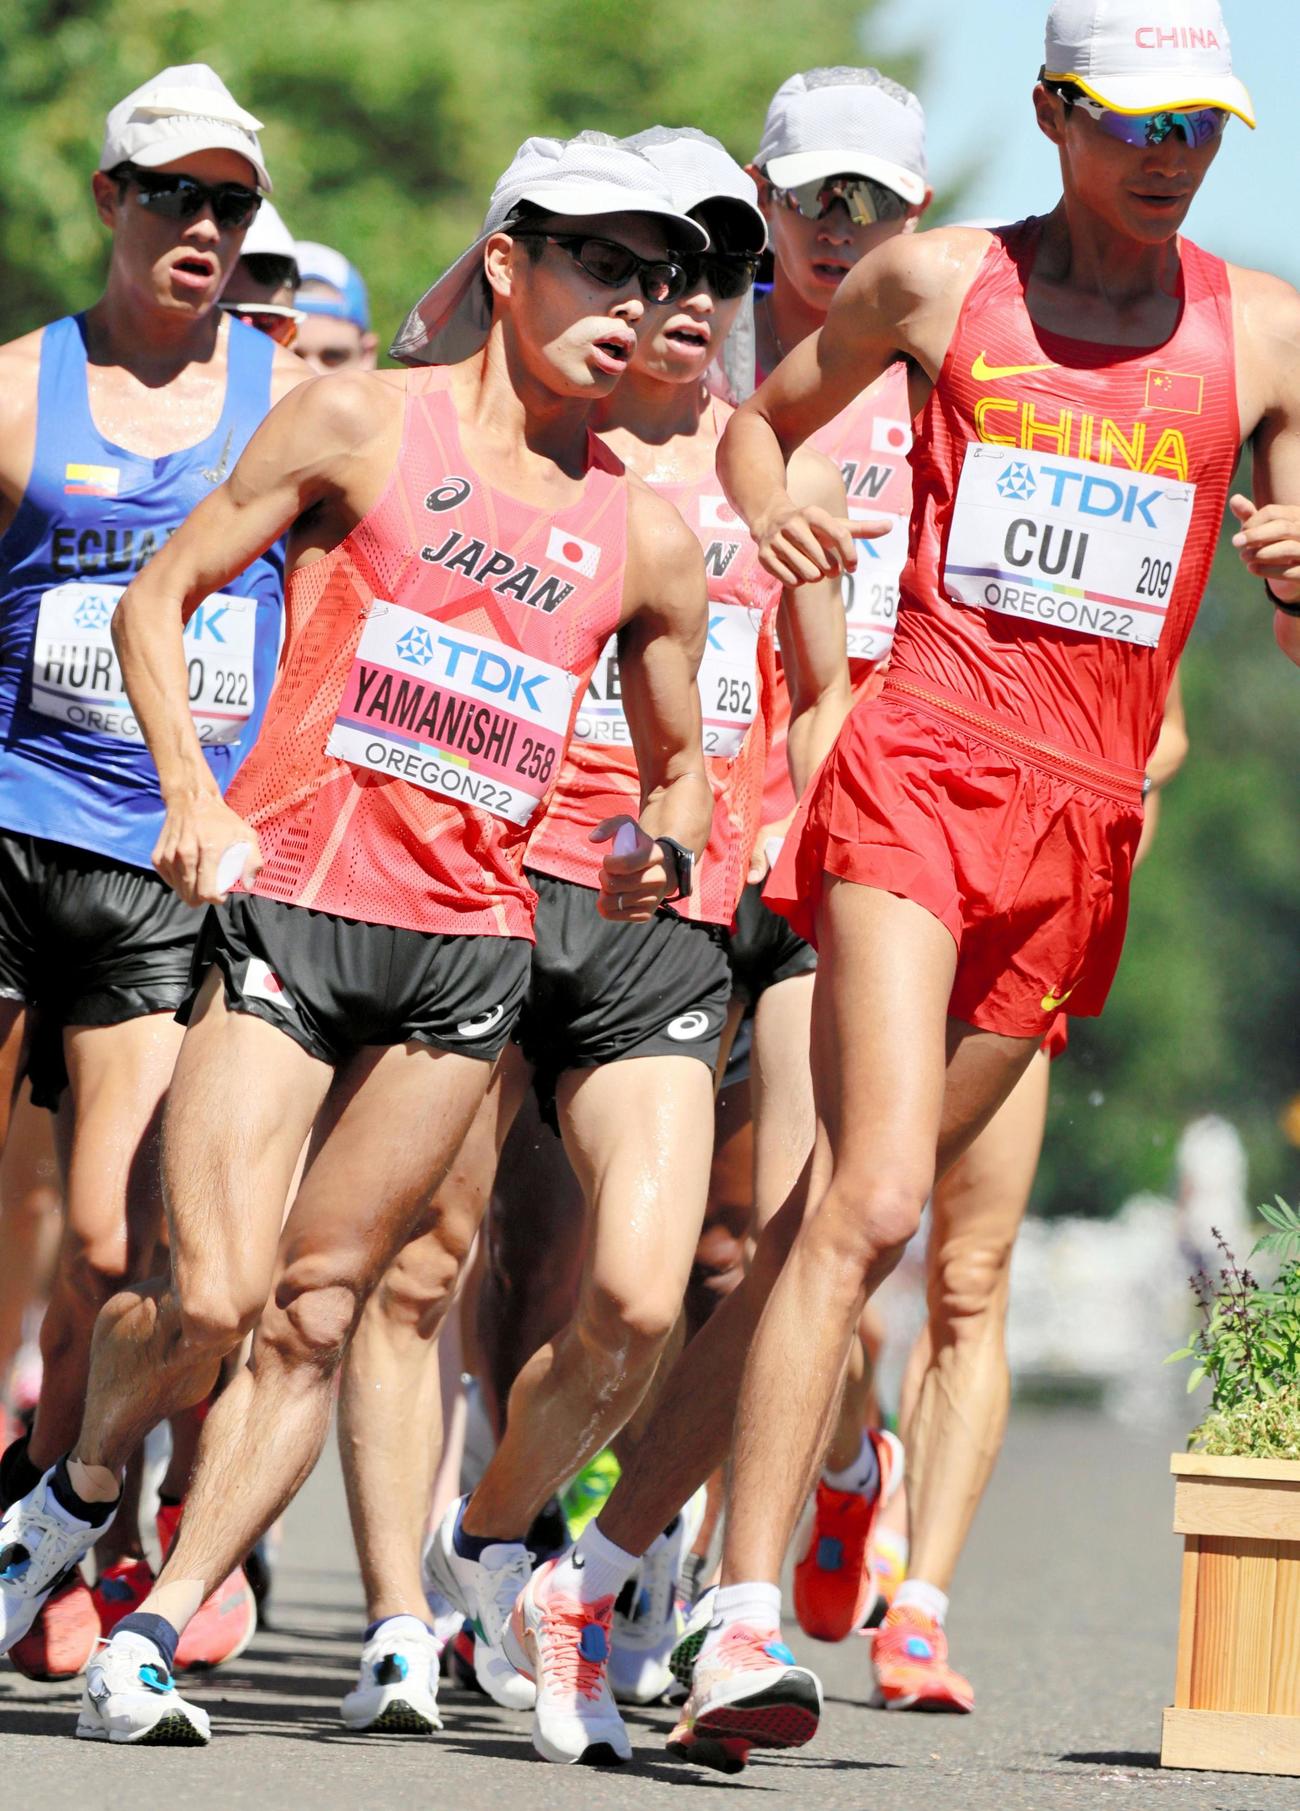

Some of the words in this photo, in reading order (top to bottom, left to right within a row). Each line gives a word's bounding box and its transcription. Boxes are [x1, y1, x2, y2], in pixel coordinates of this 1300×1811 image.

[1135, 27, 1221, 49] CHINA
[974, 397, 1188, 481] CHINA
[1040, 466, 1164, 529] TDK
[53, 528, 178, 575] ECUA
[421, 530, 576, 614] JAPAN
[1003, 518, 1089, 580] CUI
[1136, 556, 1172, 598] 209
[871, 583, 900, 618] 25
[984, 583, 1134, 636] OREGON22
[214, 670, 248, 706] 222
[438, 636, 550, 713] TDK
[717, 676, 752, 715] 252
[353, 666, 518, 767] YAMANISHI
[515, 737, 556, 785] 258
[365, 742, 513, 814] OREGON22
